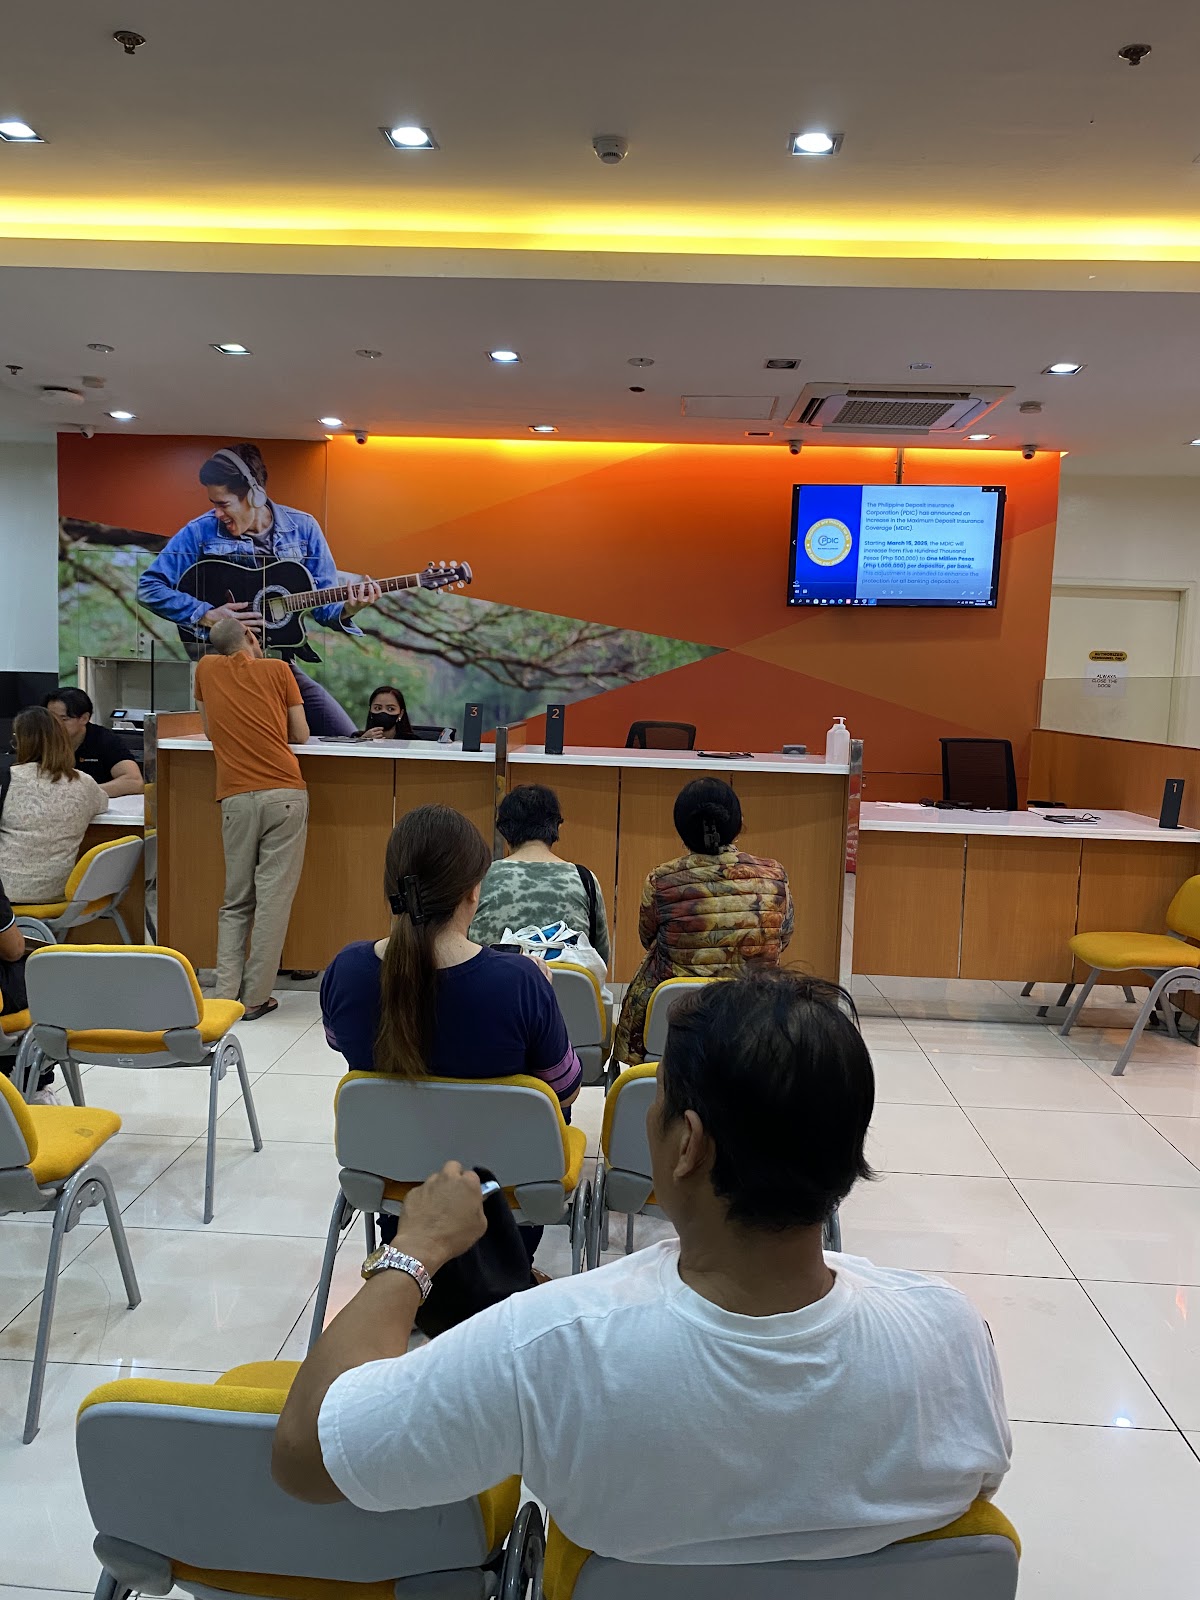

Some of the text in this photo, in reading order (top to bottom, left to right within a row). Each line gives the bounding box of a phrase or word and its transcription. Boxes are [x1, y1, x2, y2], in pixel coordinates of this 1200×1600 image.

[470, 707, 478, 716] 3
[552, 708, 559, 718] 2
[1173, 783, 1177, 792] 1
